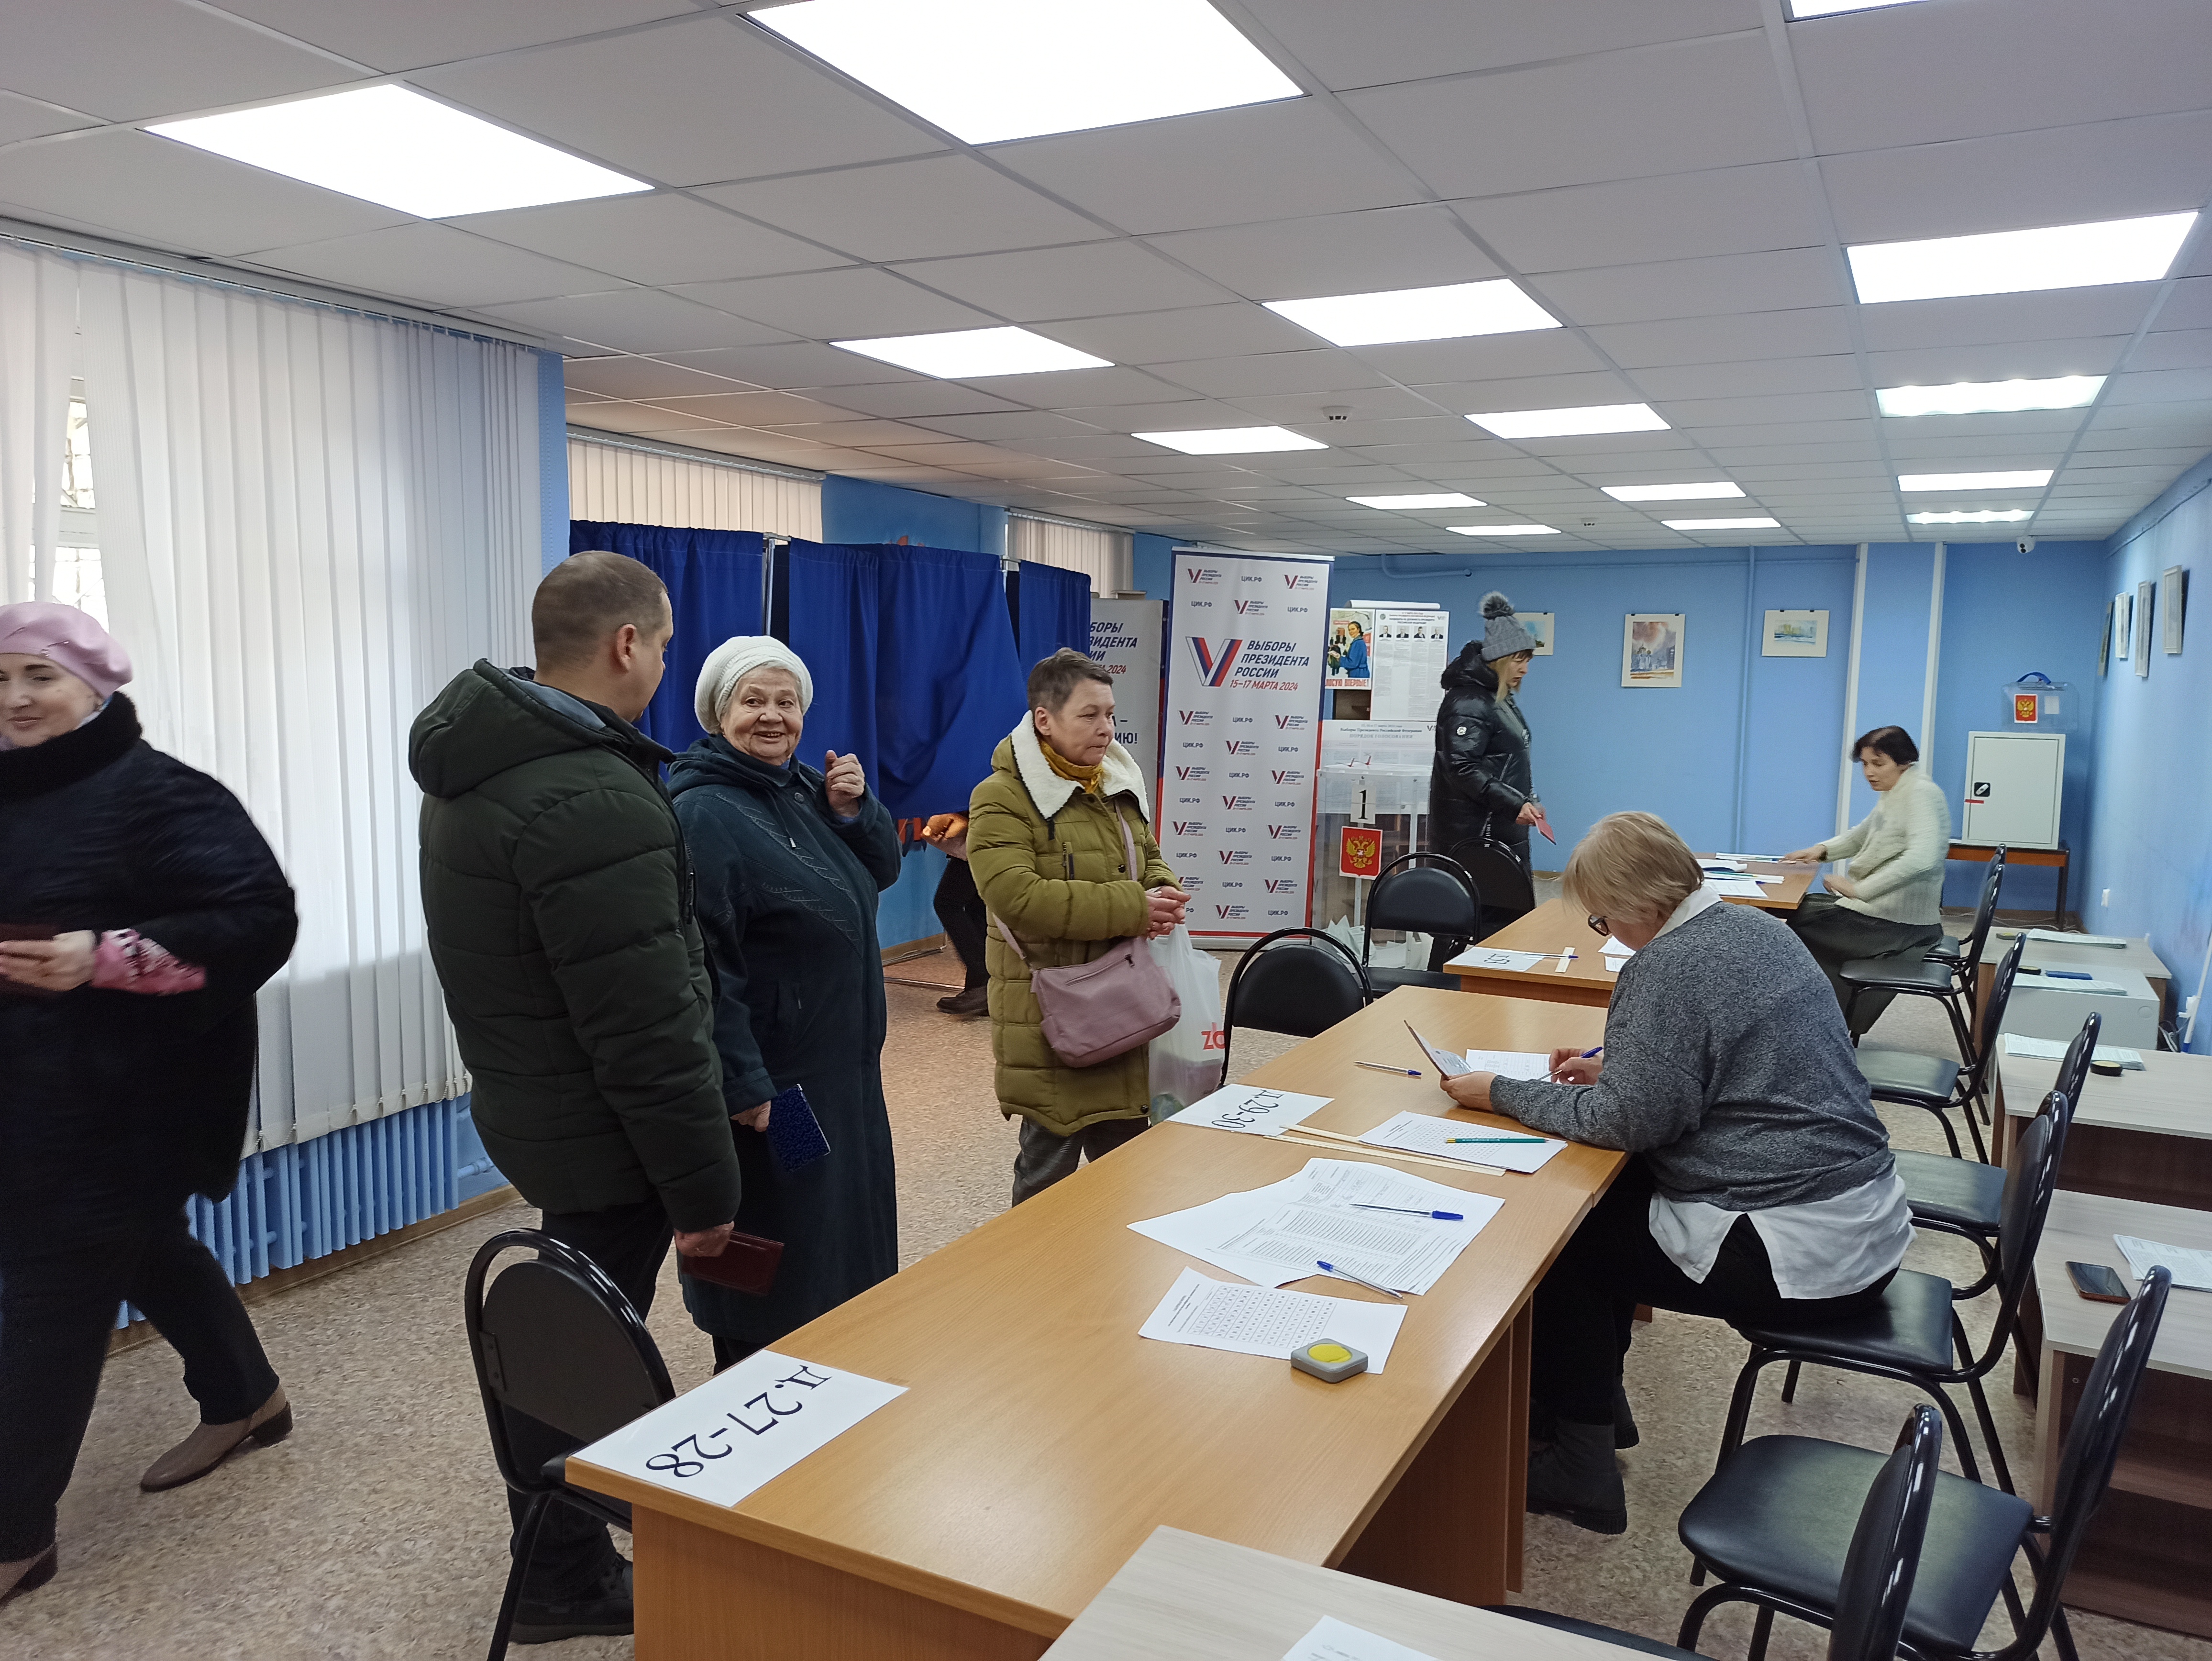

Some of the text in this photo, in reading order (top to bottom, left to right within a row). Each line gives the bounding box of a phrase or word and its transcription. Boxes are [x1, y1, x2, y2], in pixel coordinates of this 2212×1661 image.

[1090, 622, 1124, 633] БОРЫ
[1090, 636, 1138, 649] ЗИДЕНТА
[1247, 640, 1297, 652] ВЫБОРЫ
[1240, 653, 1310, 666] ПРЕЗИДЕНТА
[1107, 664, 1127, 674] 2024
[1234, 667, 1280, 678] РОССИИ
[1251, 681, 1279, 690] МАРТА
[1279, 682, 1298, 691] 2024
[1358, 789, 1369, 819] 1
